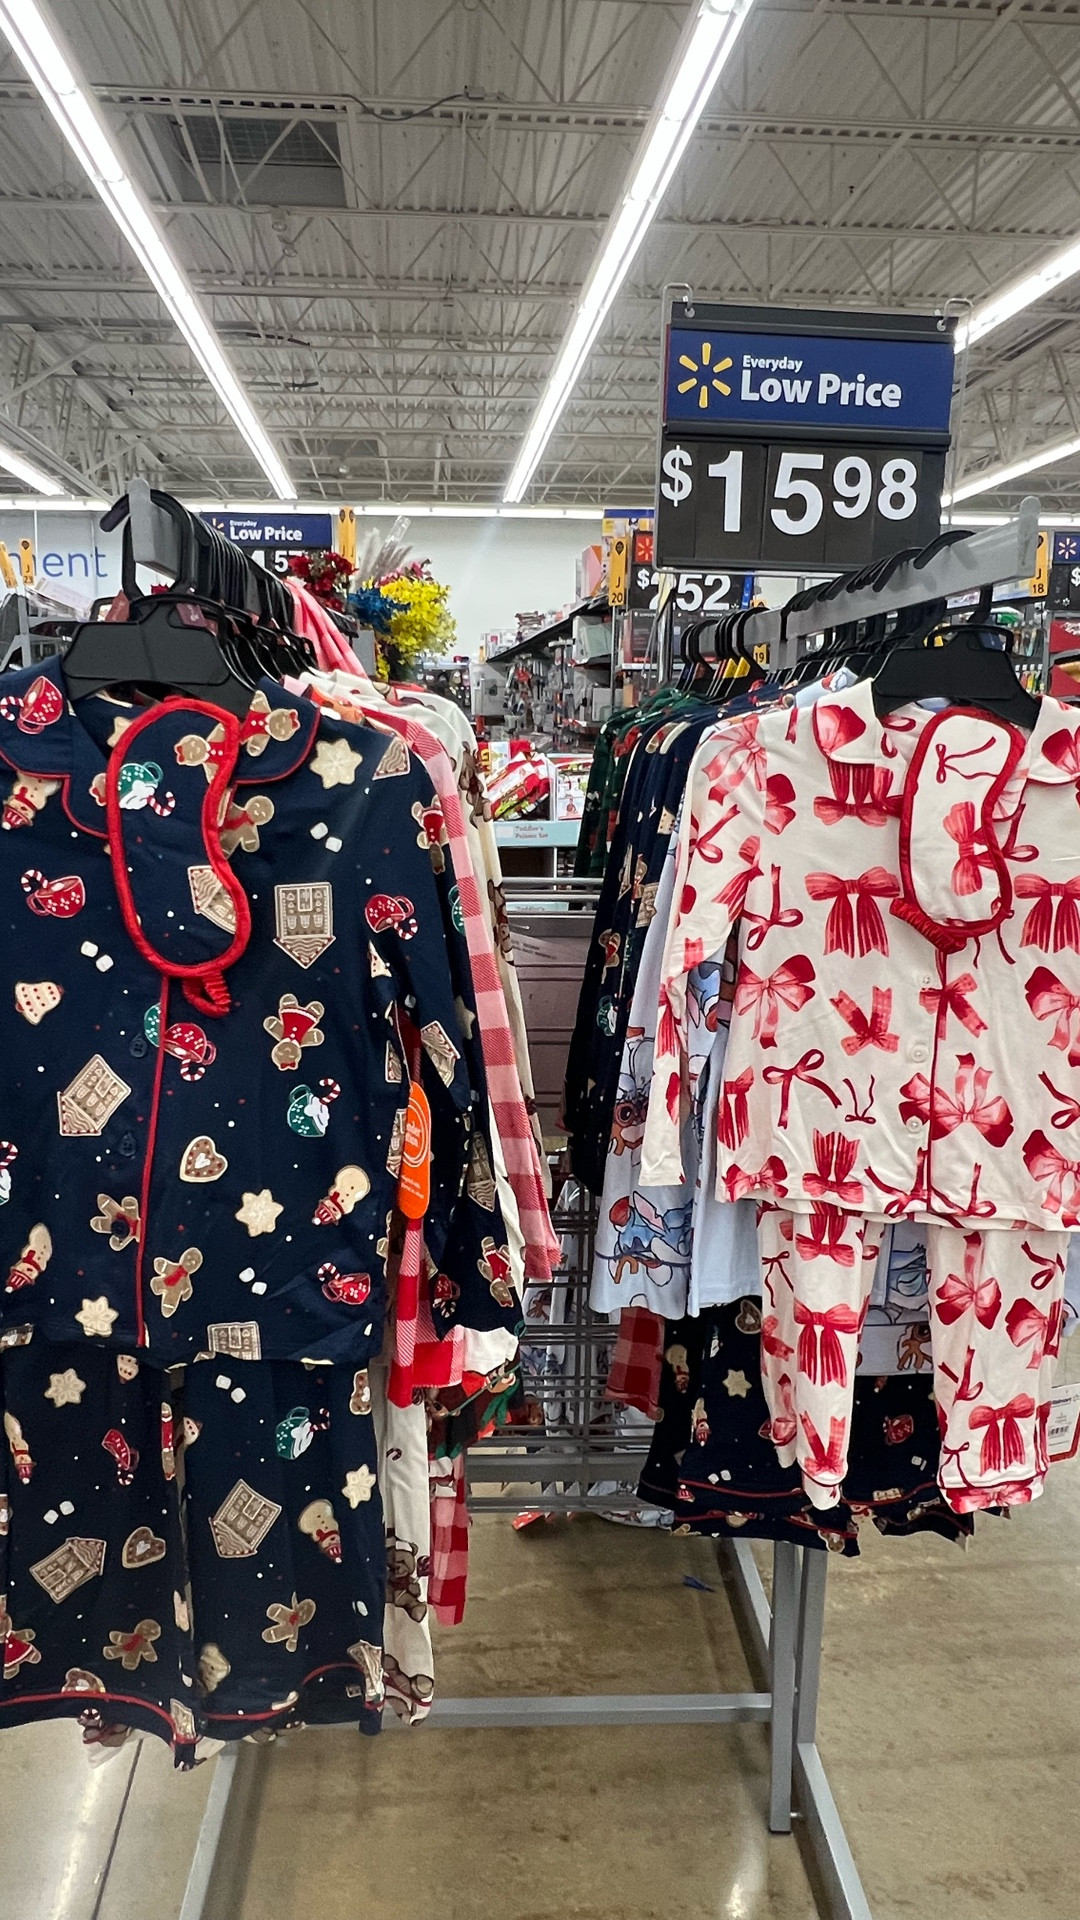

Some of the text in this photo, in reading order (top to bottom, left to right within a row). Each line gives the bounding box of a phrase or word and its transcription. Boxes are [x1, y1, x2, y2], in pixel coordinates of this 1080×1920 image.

[742, 355, 803, 373] Everyday
[740, 369, 903, 408] Low Price
[229, 526, 303, 541] Low Price
[1035, 568, 1042, 580] J
[615, 577, 621, 588] J
[1032, 584, 1045, 594] 18
[611, 593, 623, 604] 20
[754, 652, 765, 662] 19
